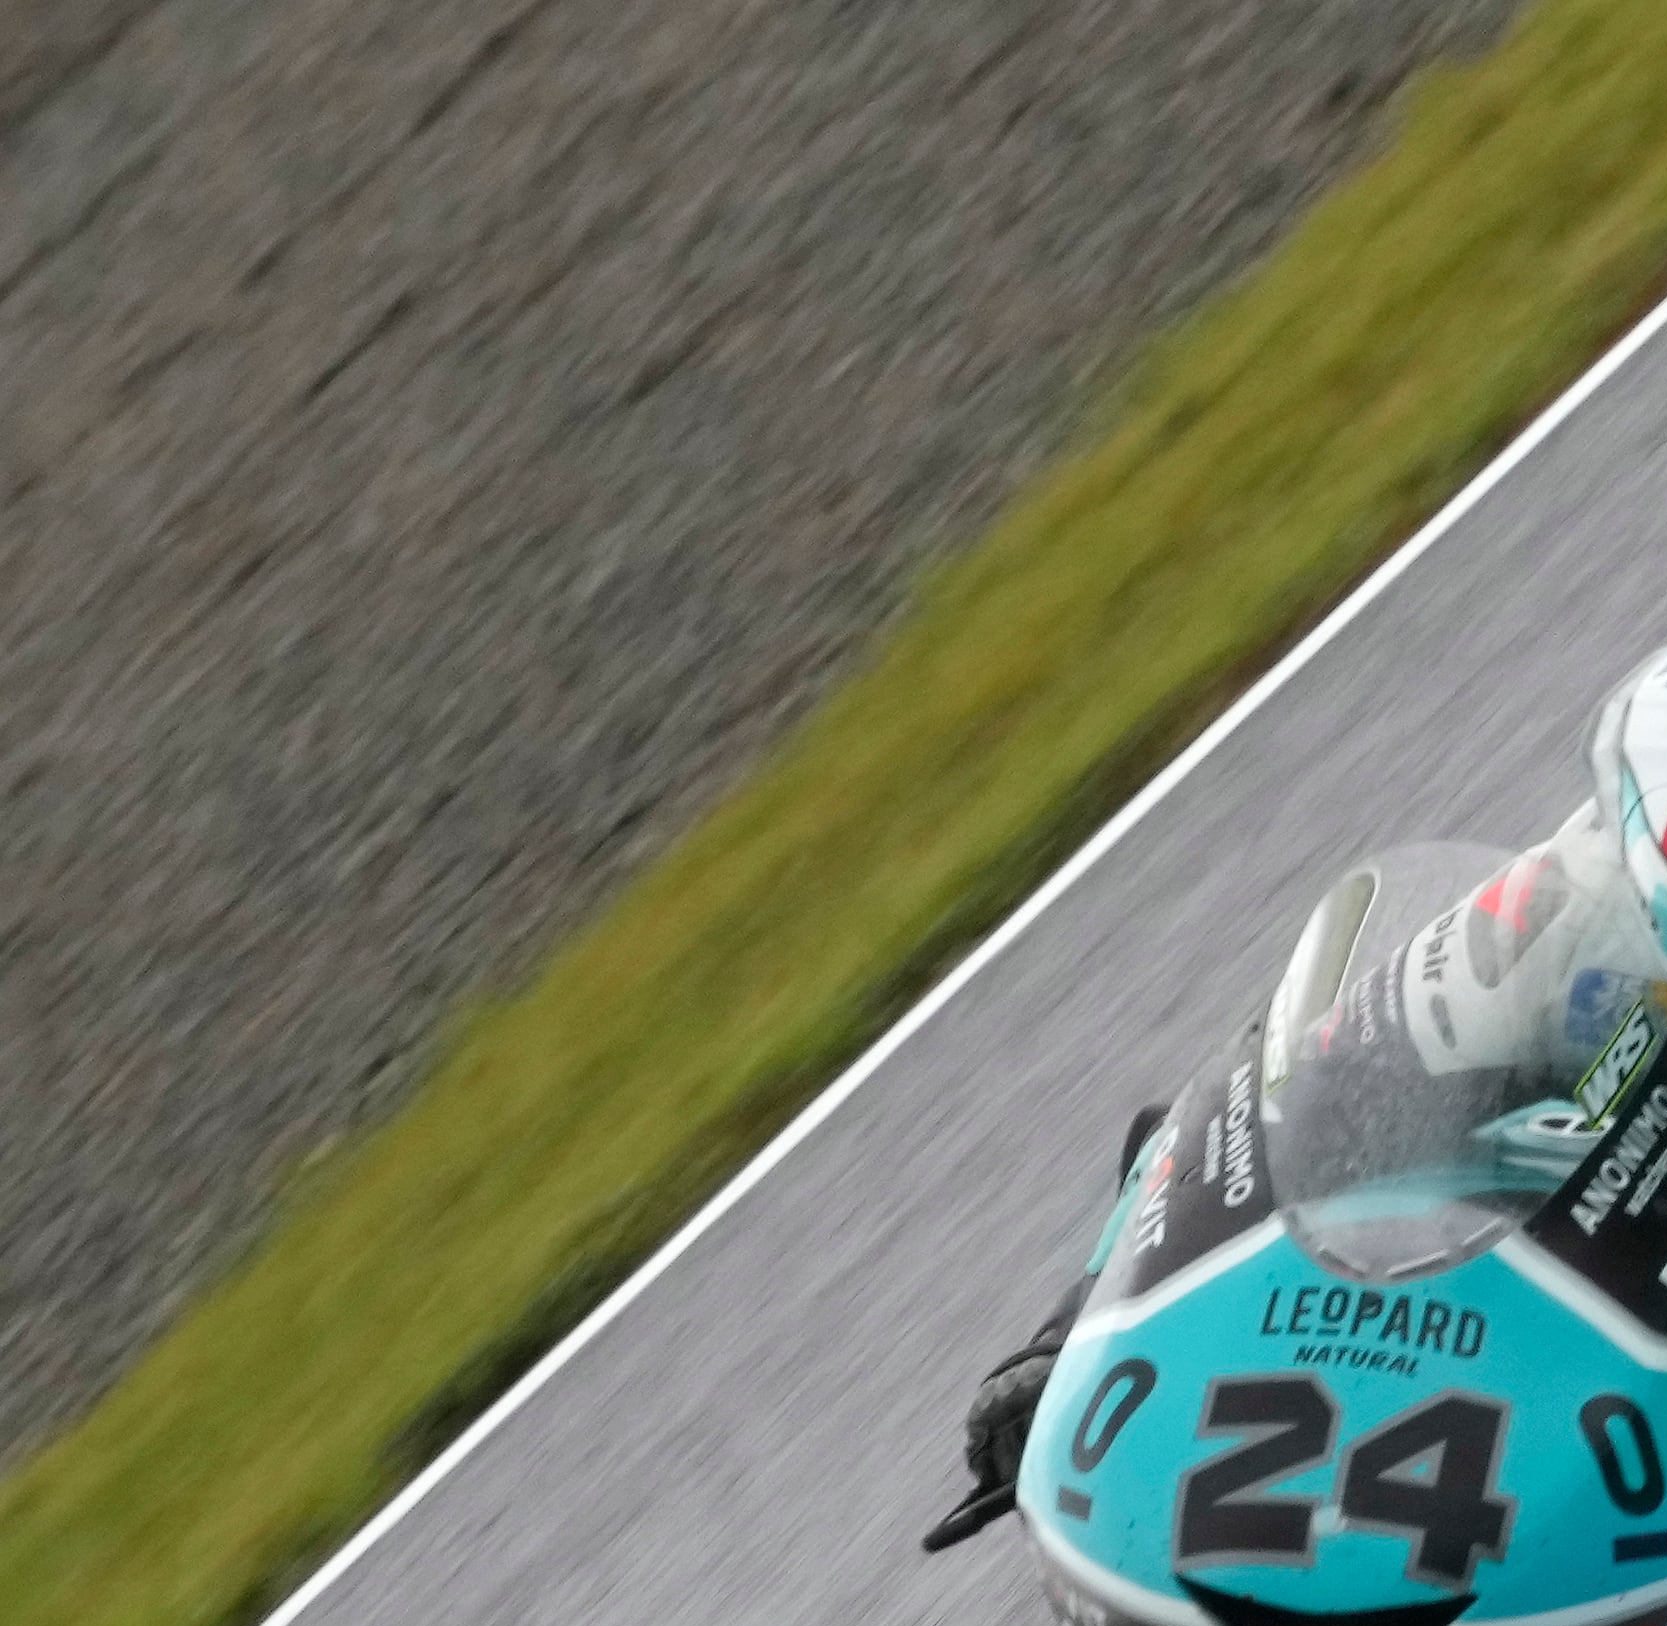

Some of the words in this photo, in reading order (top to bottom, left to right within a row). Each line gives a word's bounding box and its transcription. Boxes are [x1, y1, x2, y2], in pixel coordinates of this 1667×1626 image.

[1223, 1061, 1255, 1208] ANONIMO
[1260, 1286, 1488, 1359] LEOPARD
[1293, 1343, 1421, 1379] NATURAL
[1171, 1369, 1519, 1596] 24
